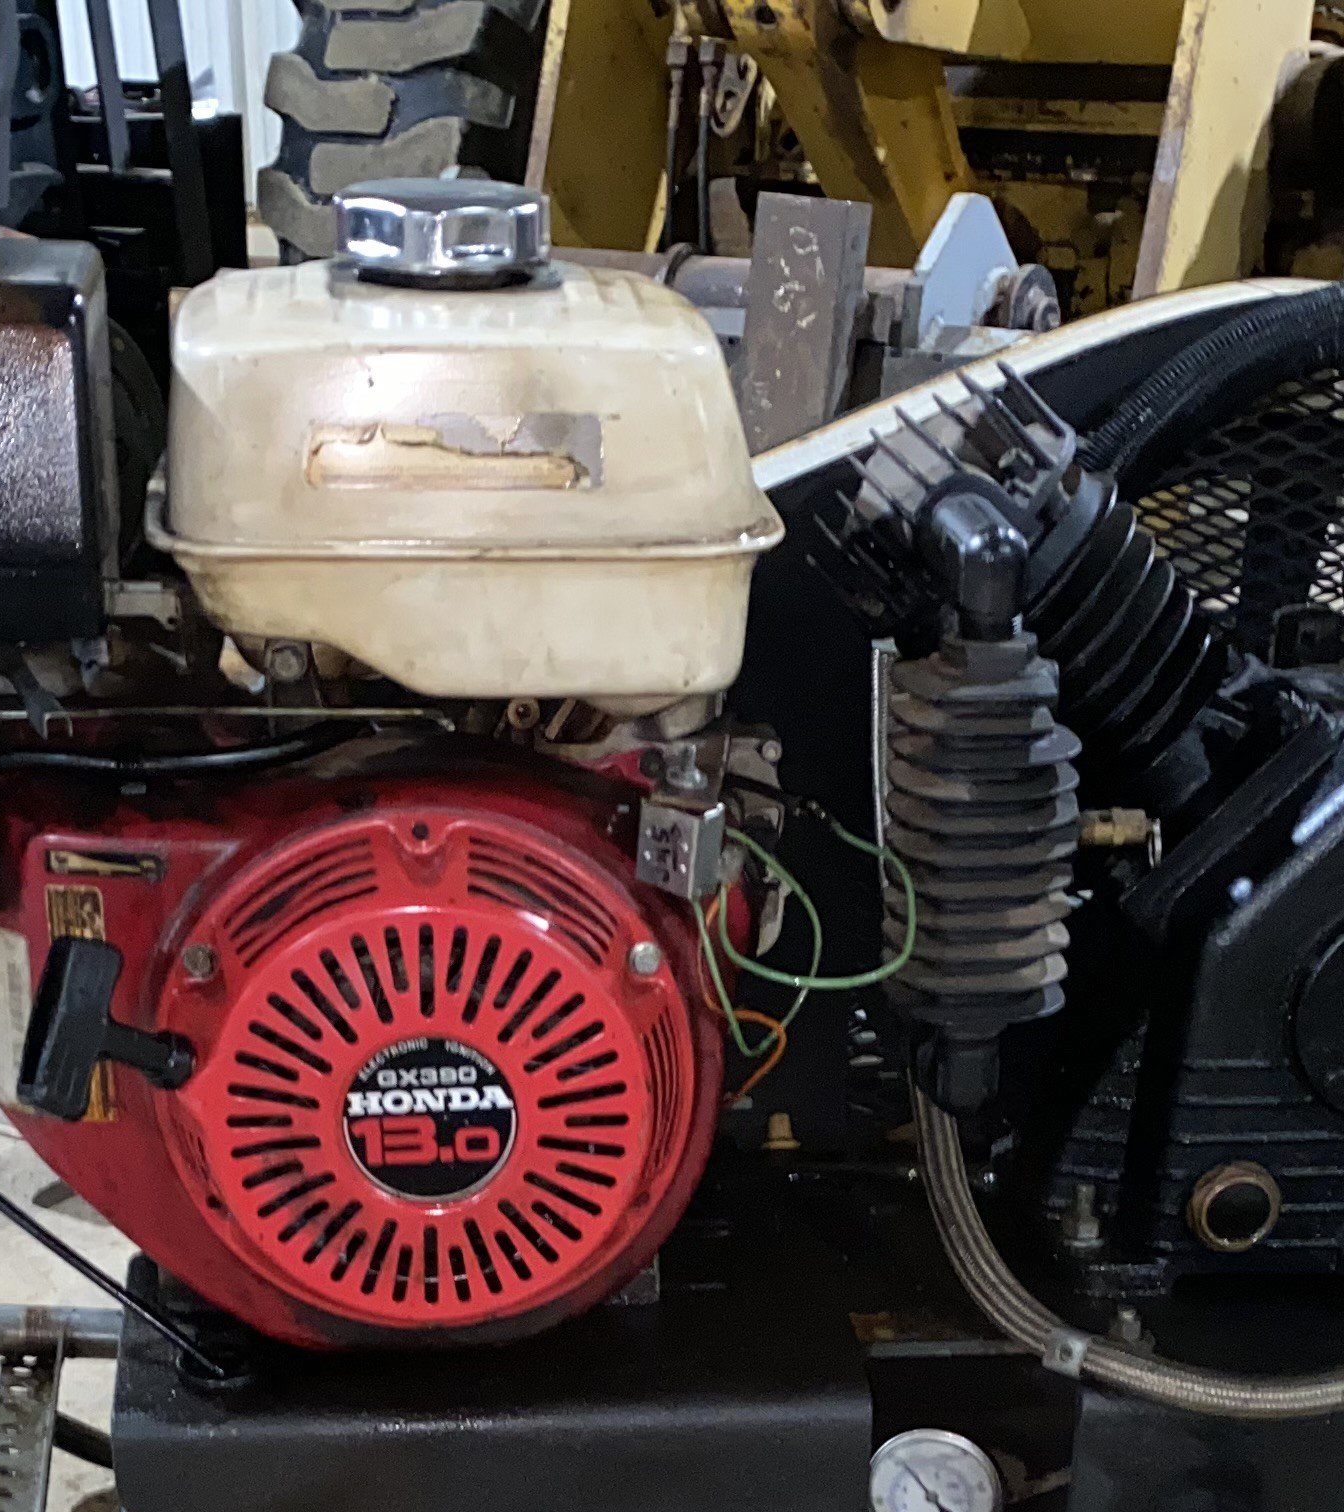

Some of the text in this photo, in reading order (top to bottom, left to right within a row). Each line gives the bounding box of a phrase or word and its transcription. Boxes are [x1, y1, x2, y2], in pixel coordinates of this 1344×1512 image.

[376, 1064, 477, 1089] GX390
[347, 1084, 514, 1117] HONDA
[350, 1114, 501, 1168] 13.0
